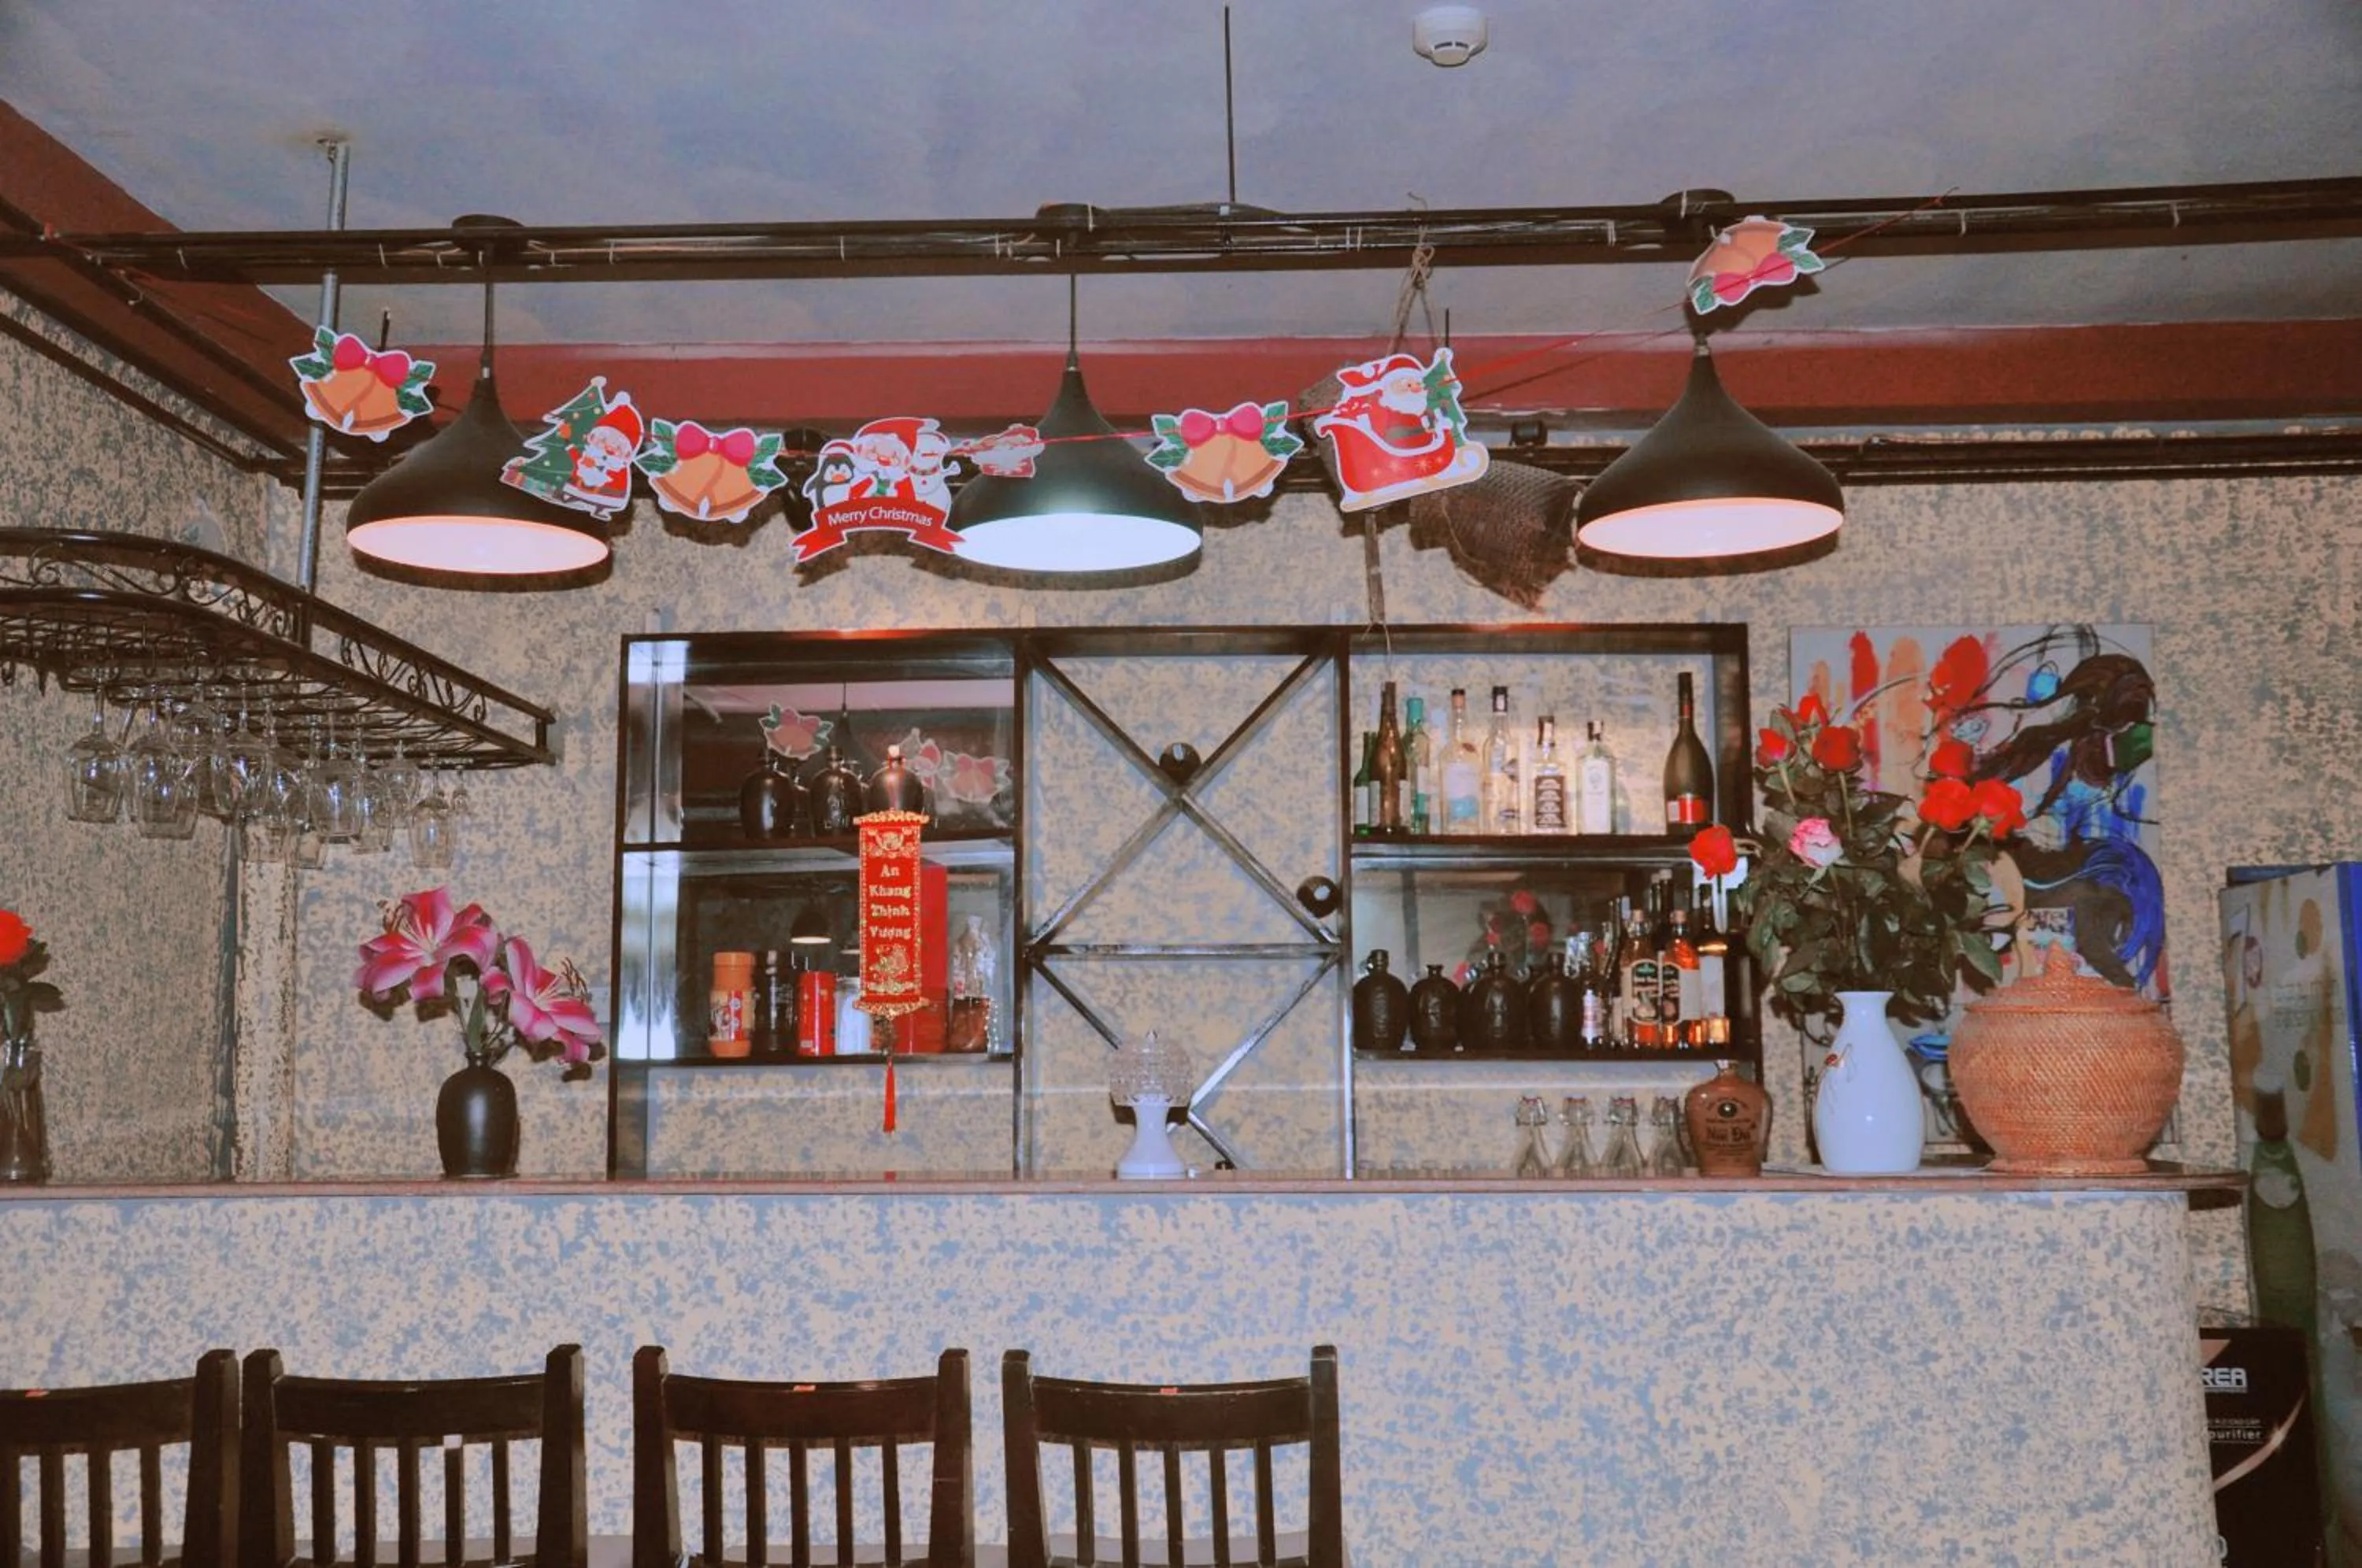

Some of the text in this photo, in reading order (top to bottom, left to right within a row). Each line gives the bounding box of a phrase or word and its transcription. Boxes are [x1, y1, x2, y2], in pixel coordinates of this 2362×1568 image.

[827, 506, 933, 527] Merry Christmas
[880, 864, 901, 878] An
[869, 884, 912, 899] Khang
[871, 904, 911, 920] Thịnh
